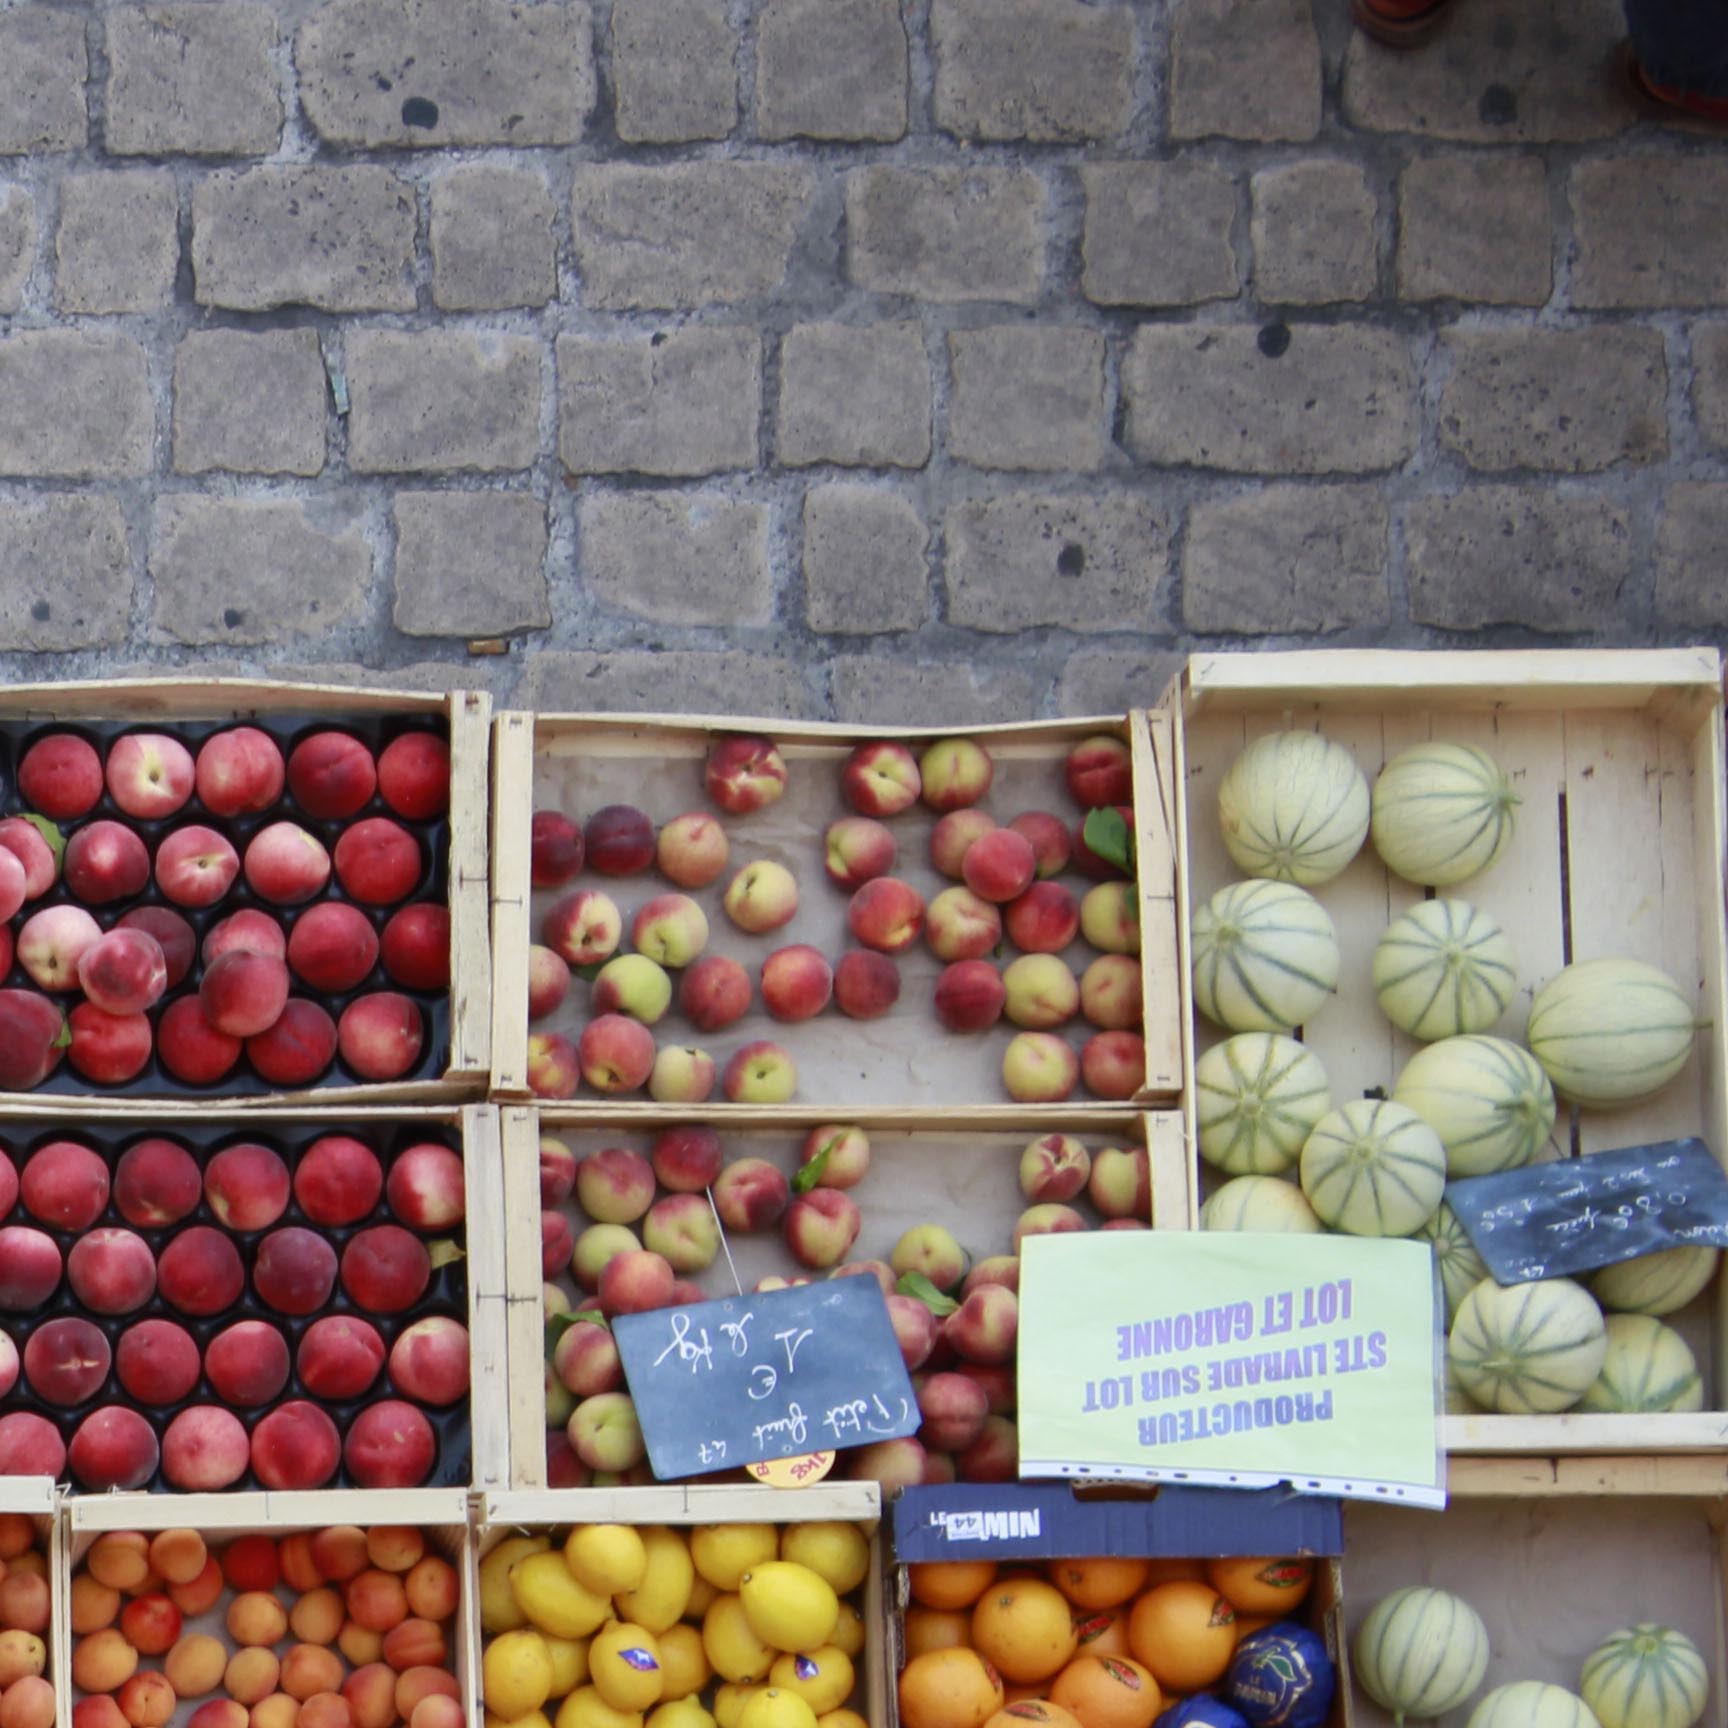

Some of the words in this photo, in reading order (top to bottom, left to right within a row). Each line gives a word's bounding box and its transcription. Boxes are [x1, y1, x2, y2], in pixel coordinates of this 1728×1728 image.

[1259, 1291, 1293, 1337] ET
[1299, 1279, 1353, 1330] LOT
[1116, 1299, 1254, 1362] GARONNE
[1334, 1330, 1387, 1374] STE
[1140, 1365, 1200, 1403] SUR
[1206, 1343, 1328, 1391] LIVRADE
[1081, 1376, 1134, 1413] LOT
[1137, 1389, 1334, 1447] PRODUCTEUR
[790, 1452, 827, 1480] 1kg
[930, 1512, 946, 1526] LE
